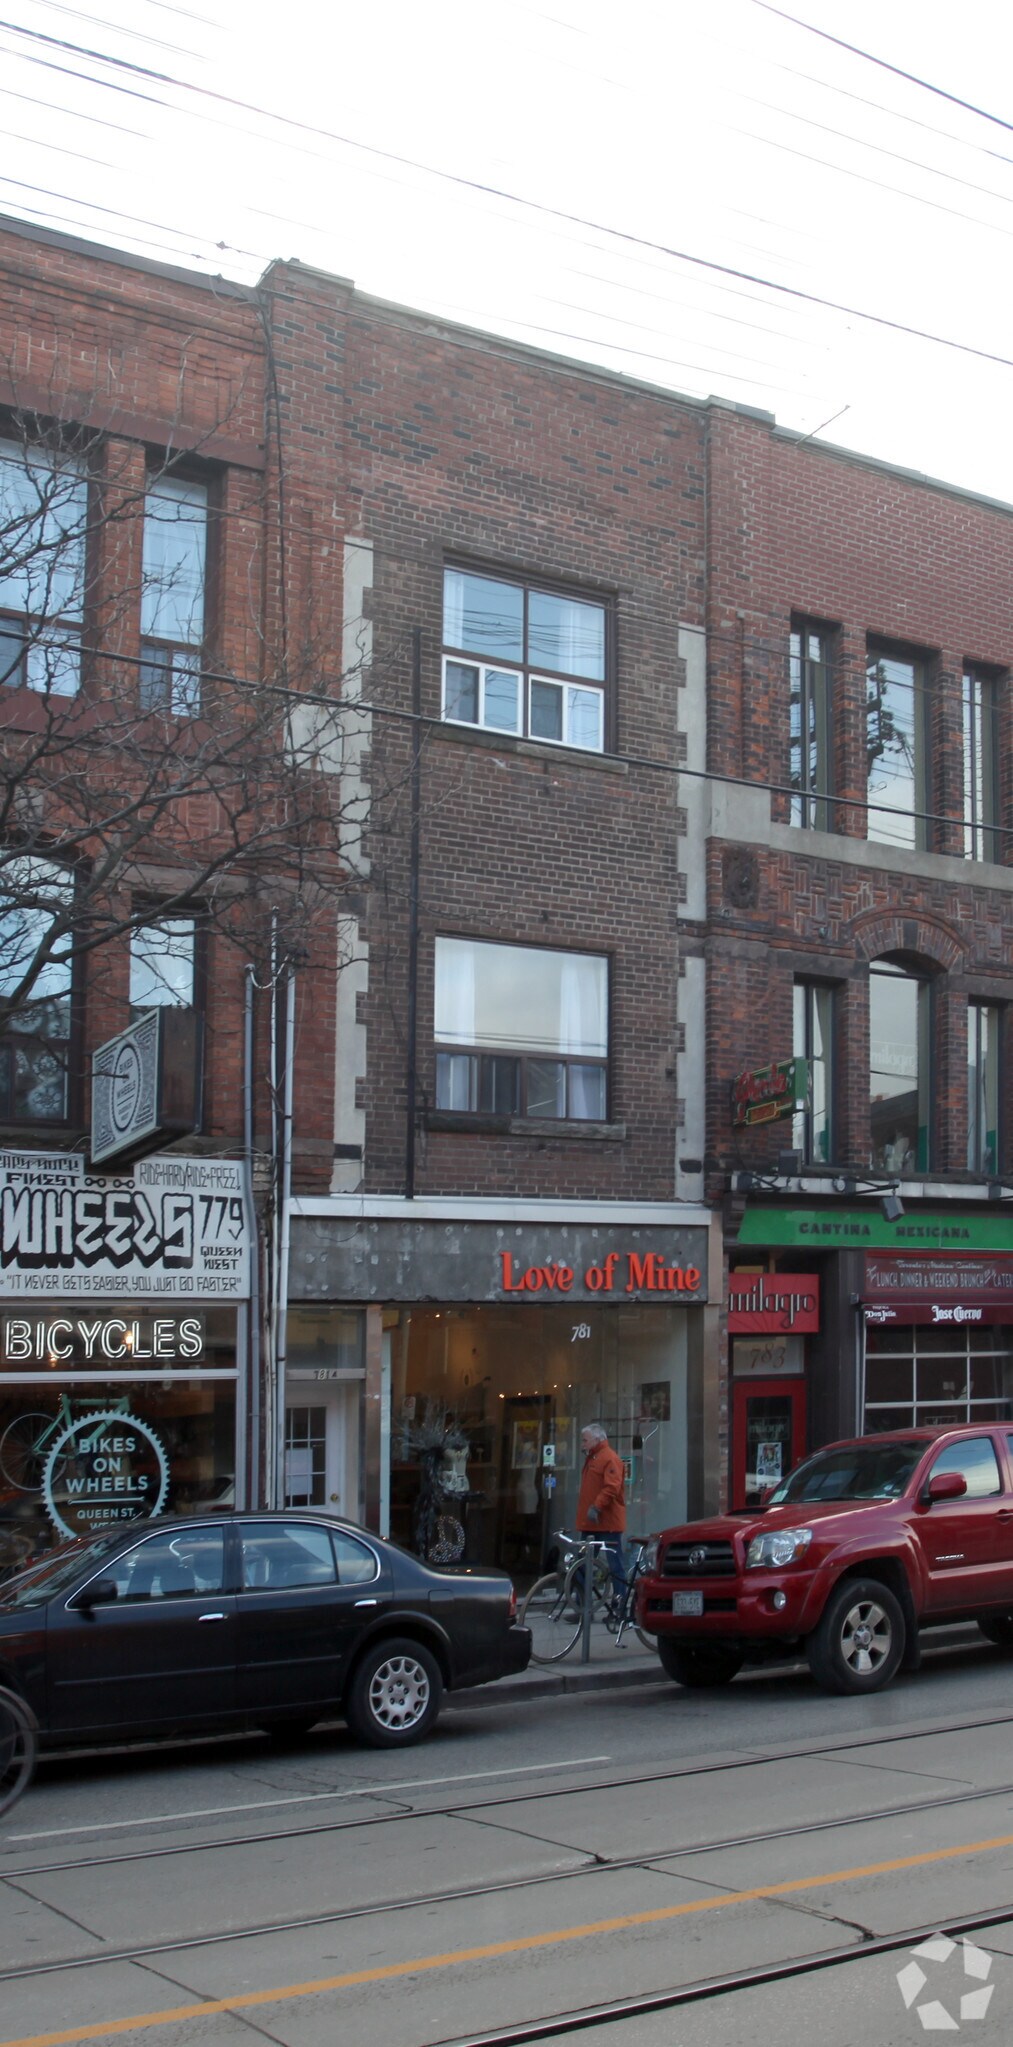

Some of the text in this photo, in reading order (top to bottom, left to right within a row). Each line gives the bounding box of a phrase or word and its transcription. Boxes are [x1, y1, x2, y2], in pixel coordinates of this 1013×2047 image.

[6, 1172, 80, 1187] FINEST
[199, 1195, 244, 1240] 779
[1, 1186, 194, 1269] WHEELS
[799, 1222, 970, 1239] CANTINA MEXICANA
[200, 1246, 242, 1257] QUEEN
[204, 1259, 239, 1271] WEST
[501, 1252, 701, 1291] Love of Mine
[24, 1275, 59, 1290] NEVER
[63, 1275, 91, 1291] GETS
[153, 1277, 176, 1292] JUST
[179, 1277, 193, 1292] GO
[901, 1273, 923, 1288] DINNER
[929, 1273, 958, 1288] WEEKEND
[960, 1273, 984, 1288] BRUNCH
[865, 1311, 881, 1319] Don
[880, 1310, 897, 1321] Julio
[953, 1306, 982, 1322] Cuervo
[5, 1319, 203, 1360] BICYCLES
[571, 1323, 591, 1342] 781
[750, 1342, 786, 1369] 783
[79, 1437, 136, 1453] BIKES
[93, 1458, 121, 1472] ON
[66, 1476, 148, 1493] WHEELS
[77, 1507, 136, 1519] QUEEN ST.
